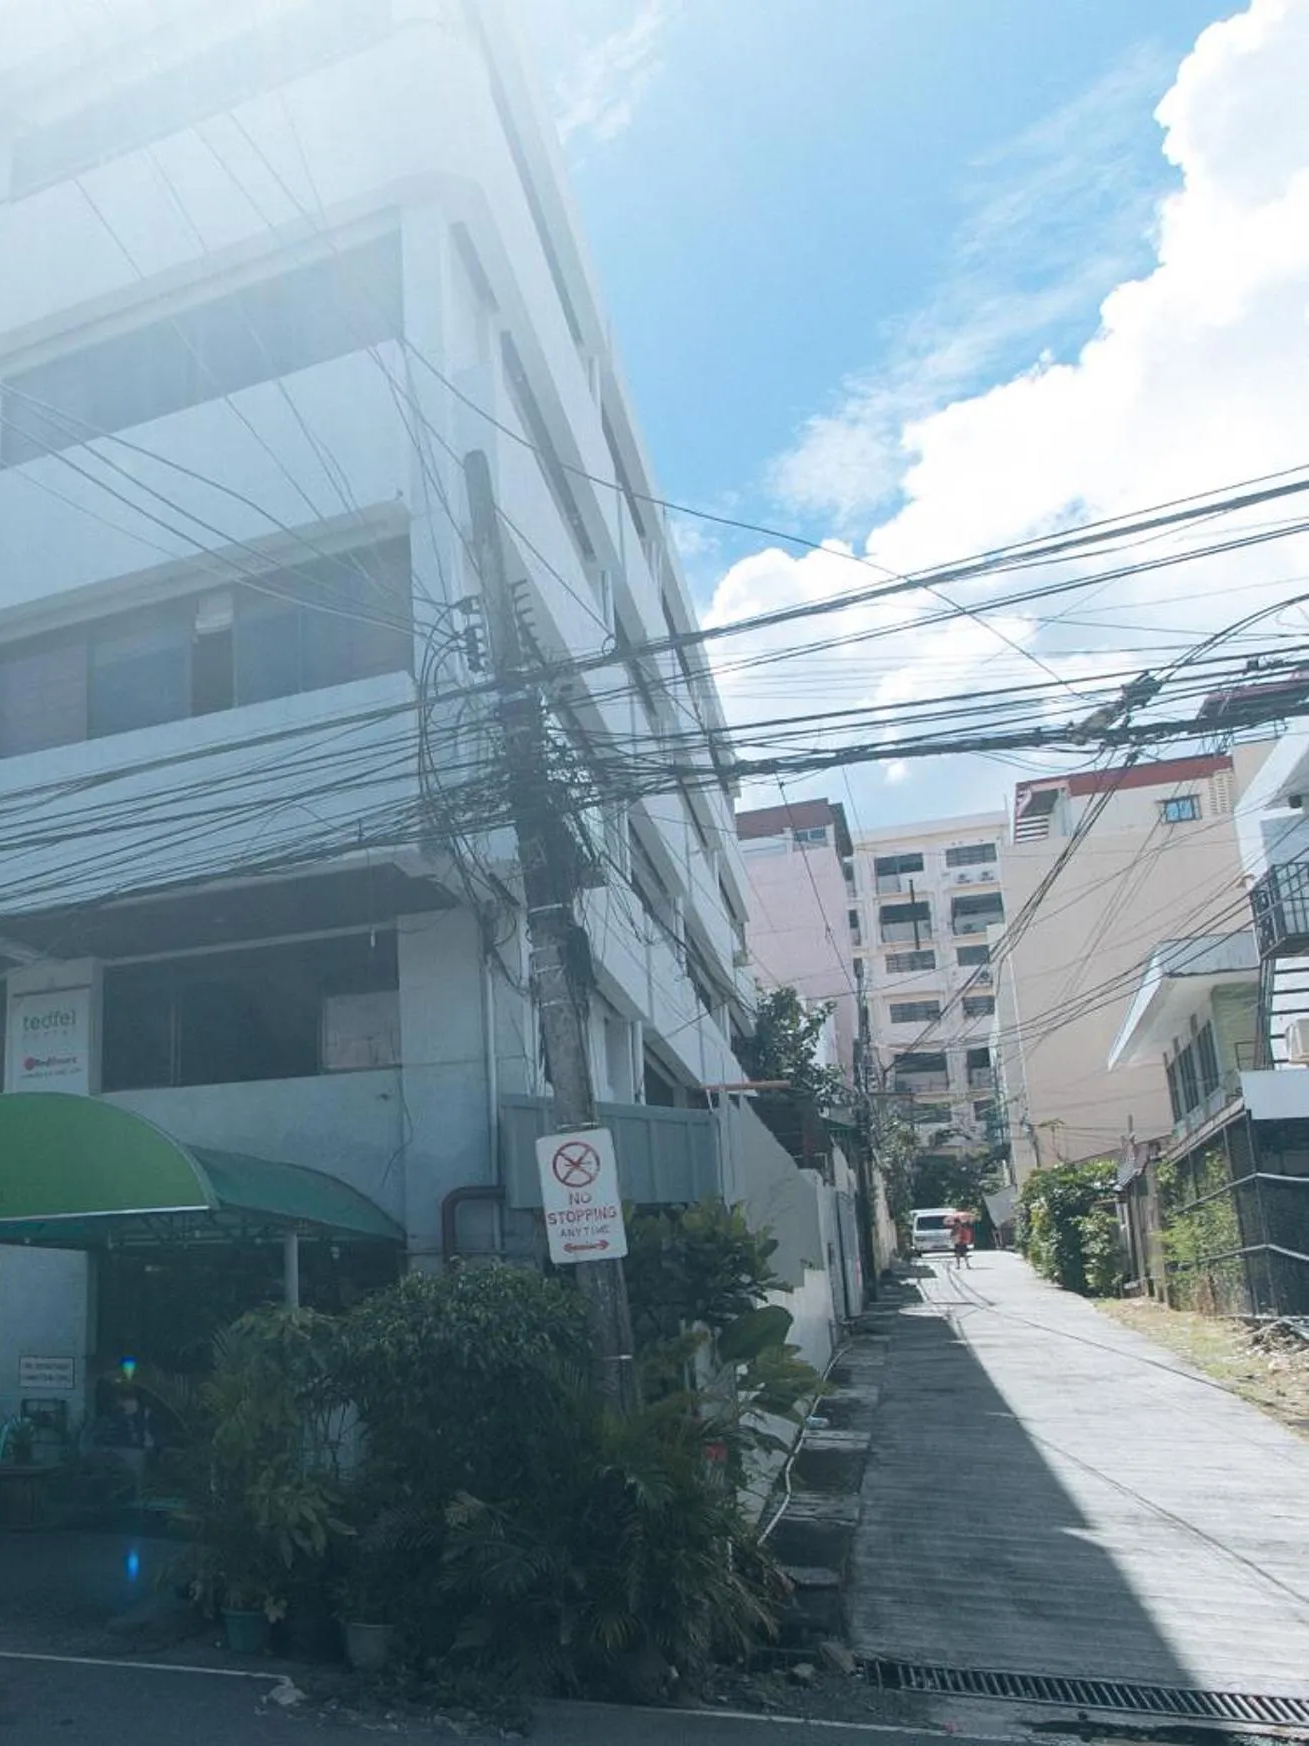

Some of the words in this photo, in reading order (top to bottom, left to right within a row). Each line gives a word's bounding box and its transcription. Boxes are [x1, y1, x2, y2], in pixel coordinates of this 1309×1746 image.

[569, 1192, 592, 1205] NO
[547, 1206, 617, 1225] STOPPING
[561, 1225, 610, 1237] ANYTIME
